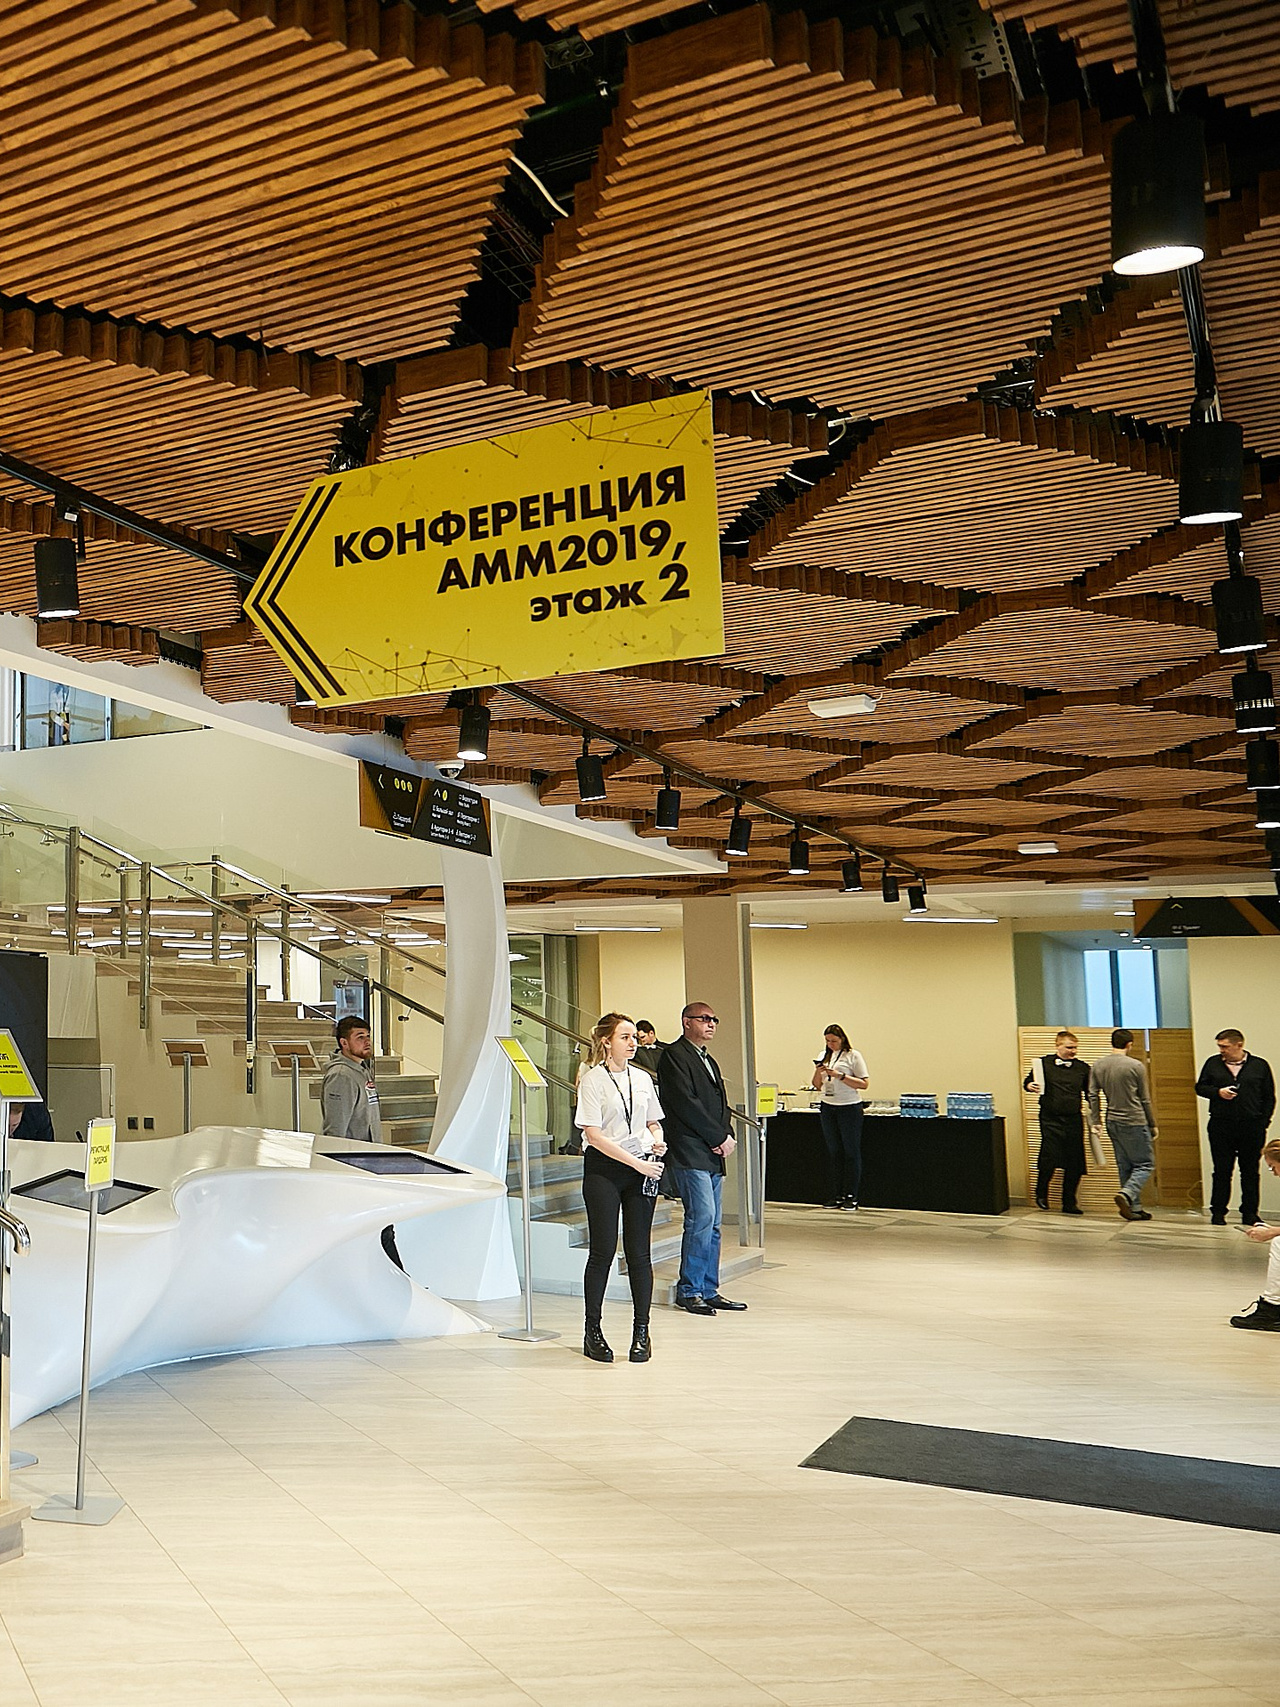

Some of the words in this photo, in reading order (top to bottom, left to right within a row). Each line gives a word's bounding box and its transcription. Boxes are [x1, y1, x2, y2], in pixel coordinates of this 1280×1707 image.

[333, 465, 686, 568] КОНФЕРЕНЦИЯ
[529, 580, 647, 622] этаж
[659, 563, 690, 602] 2
